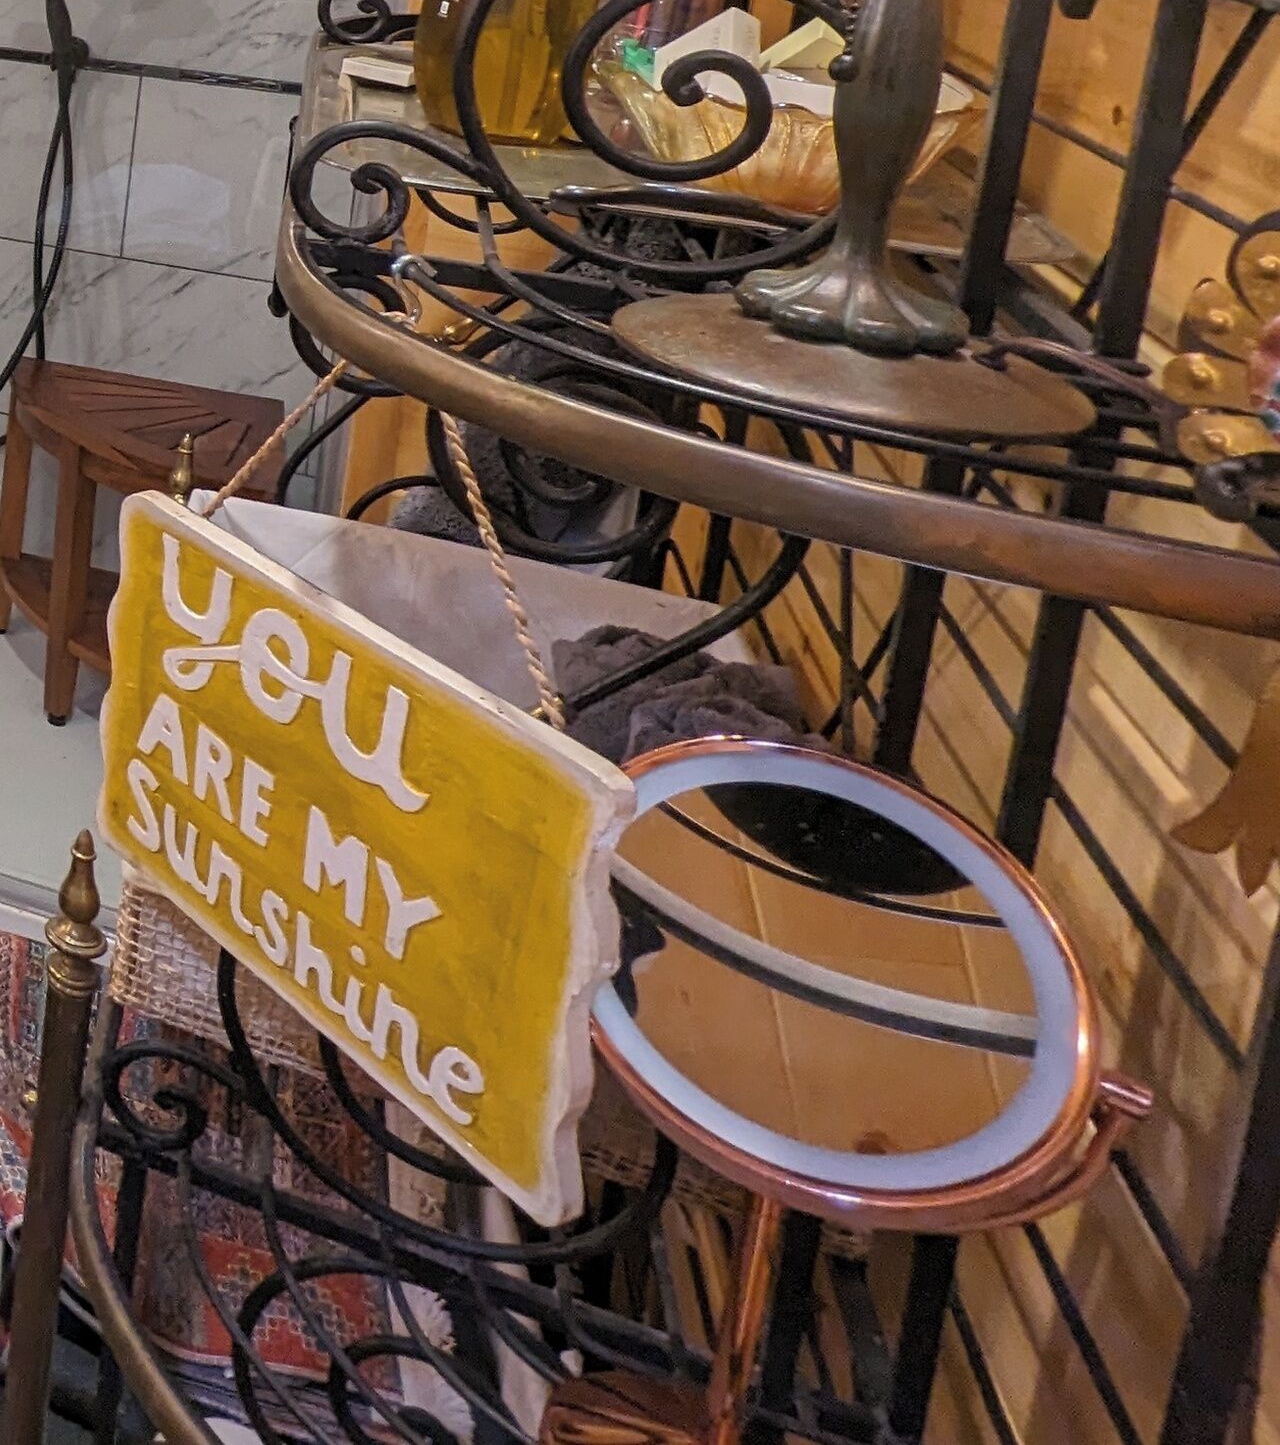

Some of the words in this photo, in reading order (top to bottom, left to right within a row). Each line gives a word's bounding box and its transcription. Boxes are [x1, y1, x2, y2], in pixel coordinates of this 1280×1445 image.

[126, 759, 485, 1126] Sunshine
[136, 693, 276, 847] ARE
[303, 805, 442, 960] MY
